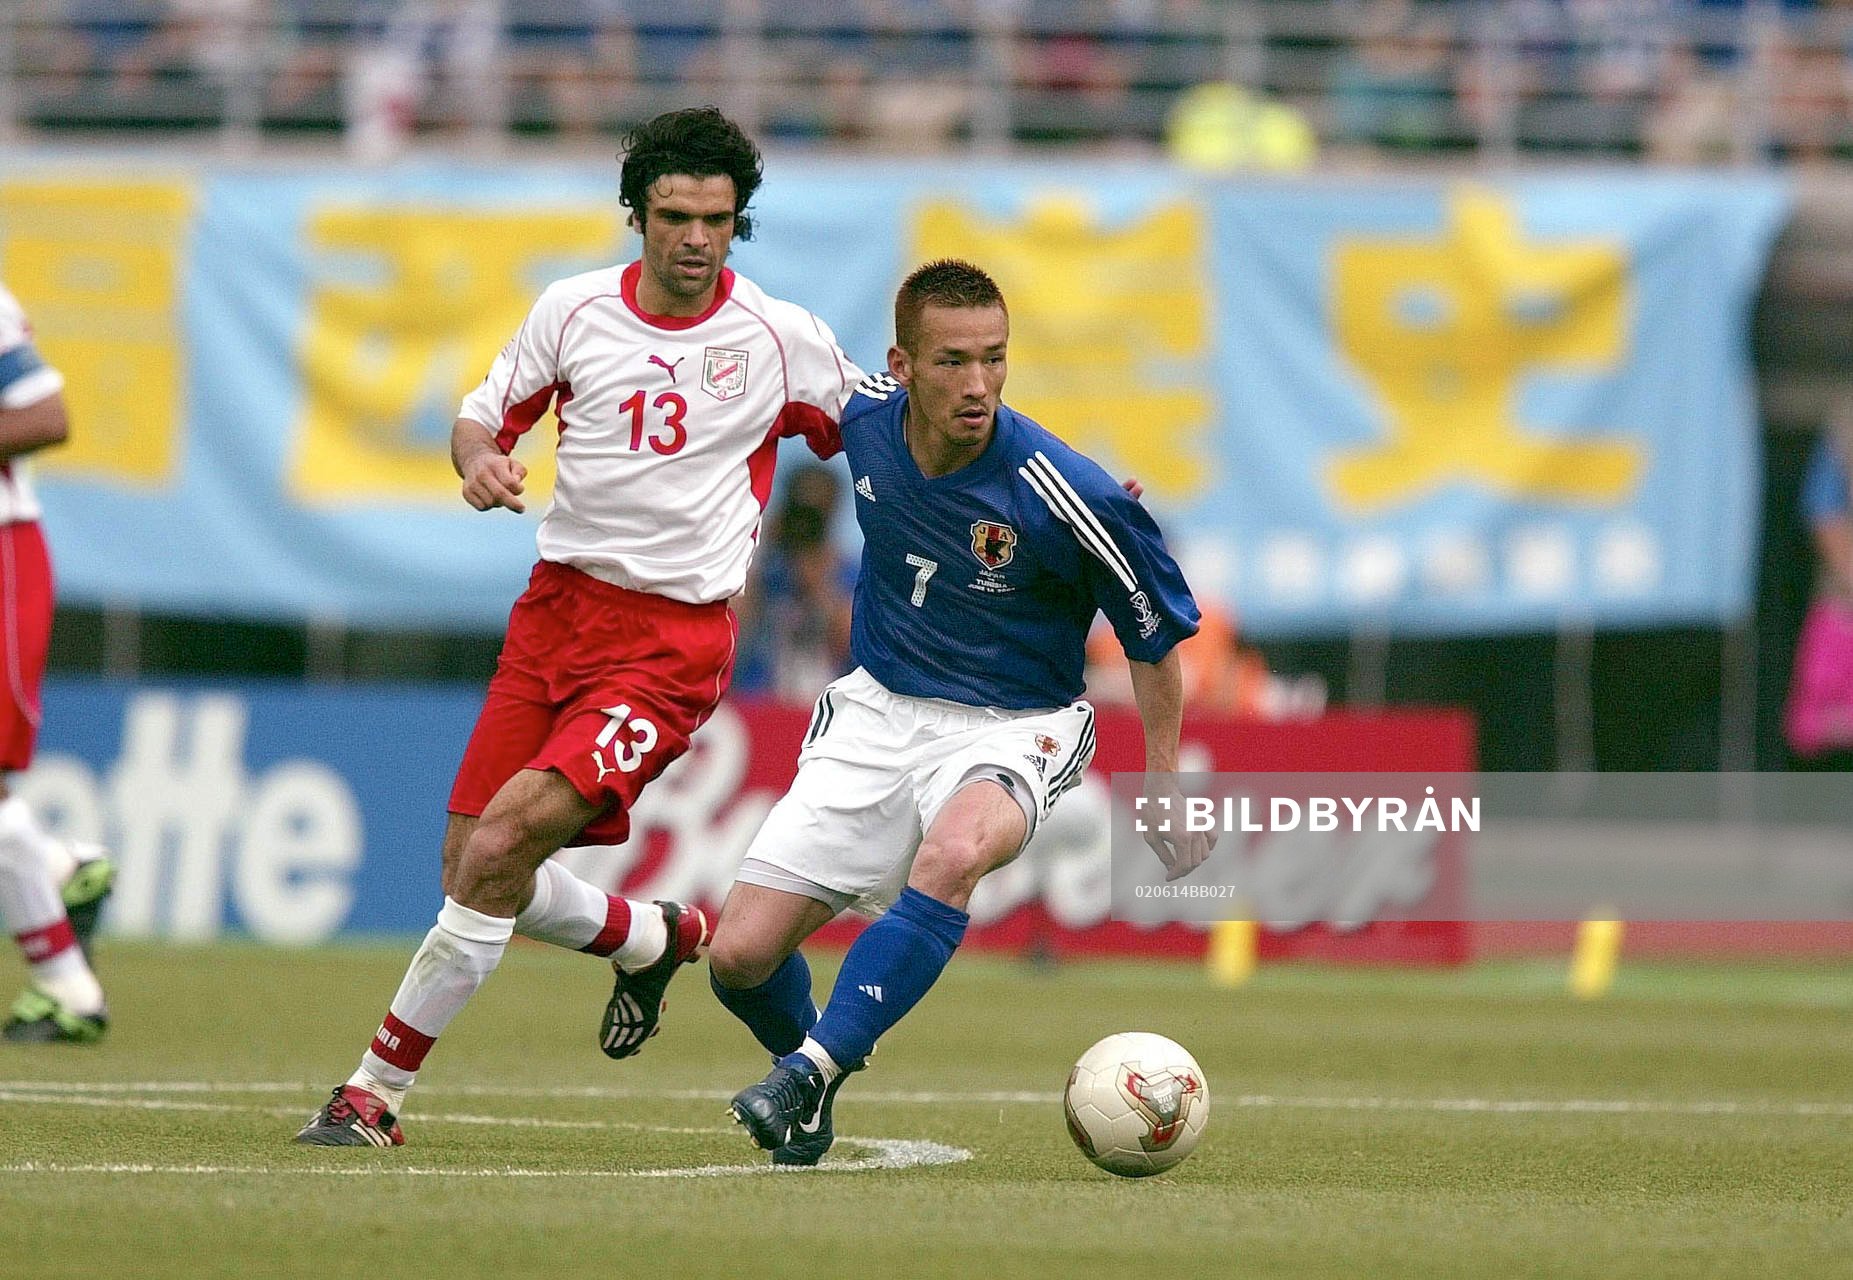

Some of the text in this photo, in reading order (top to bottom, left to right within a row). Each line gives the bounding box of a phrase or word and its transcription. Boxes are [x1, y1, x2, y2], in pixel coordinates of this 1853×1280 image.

[618, 389, 688, 456] 13
[905, 553, 938, 608] 7
[595, 703, 659, 773] 13
[376, 1023, 401, 1052] MA
